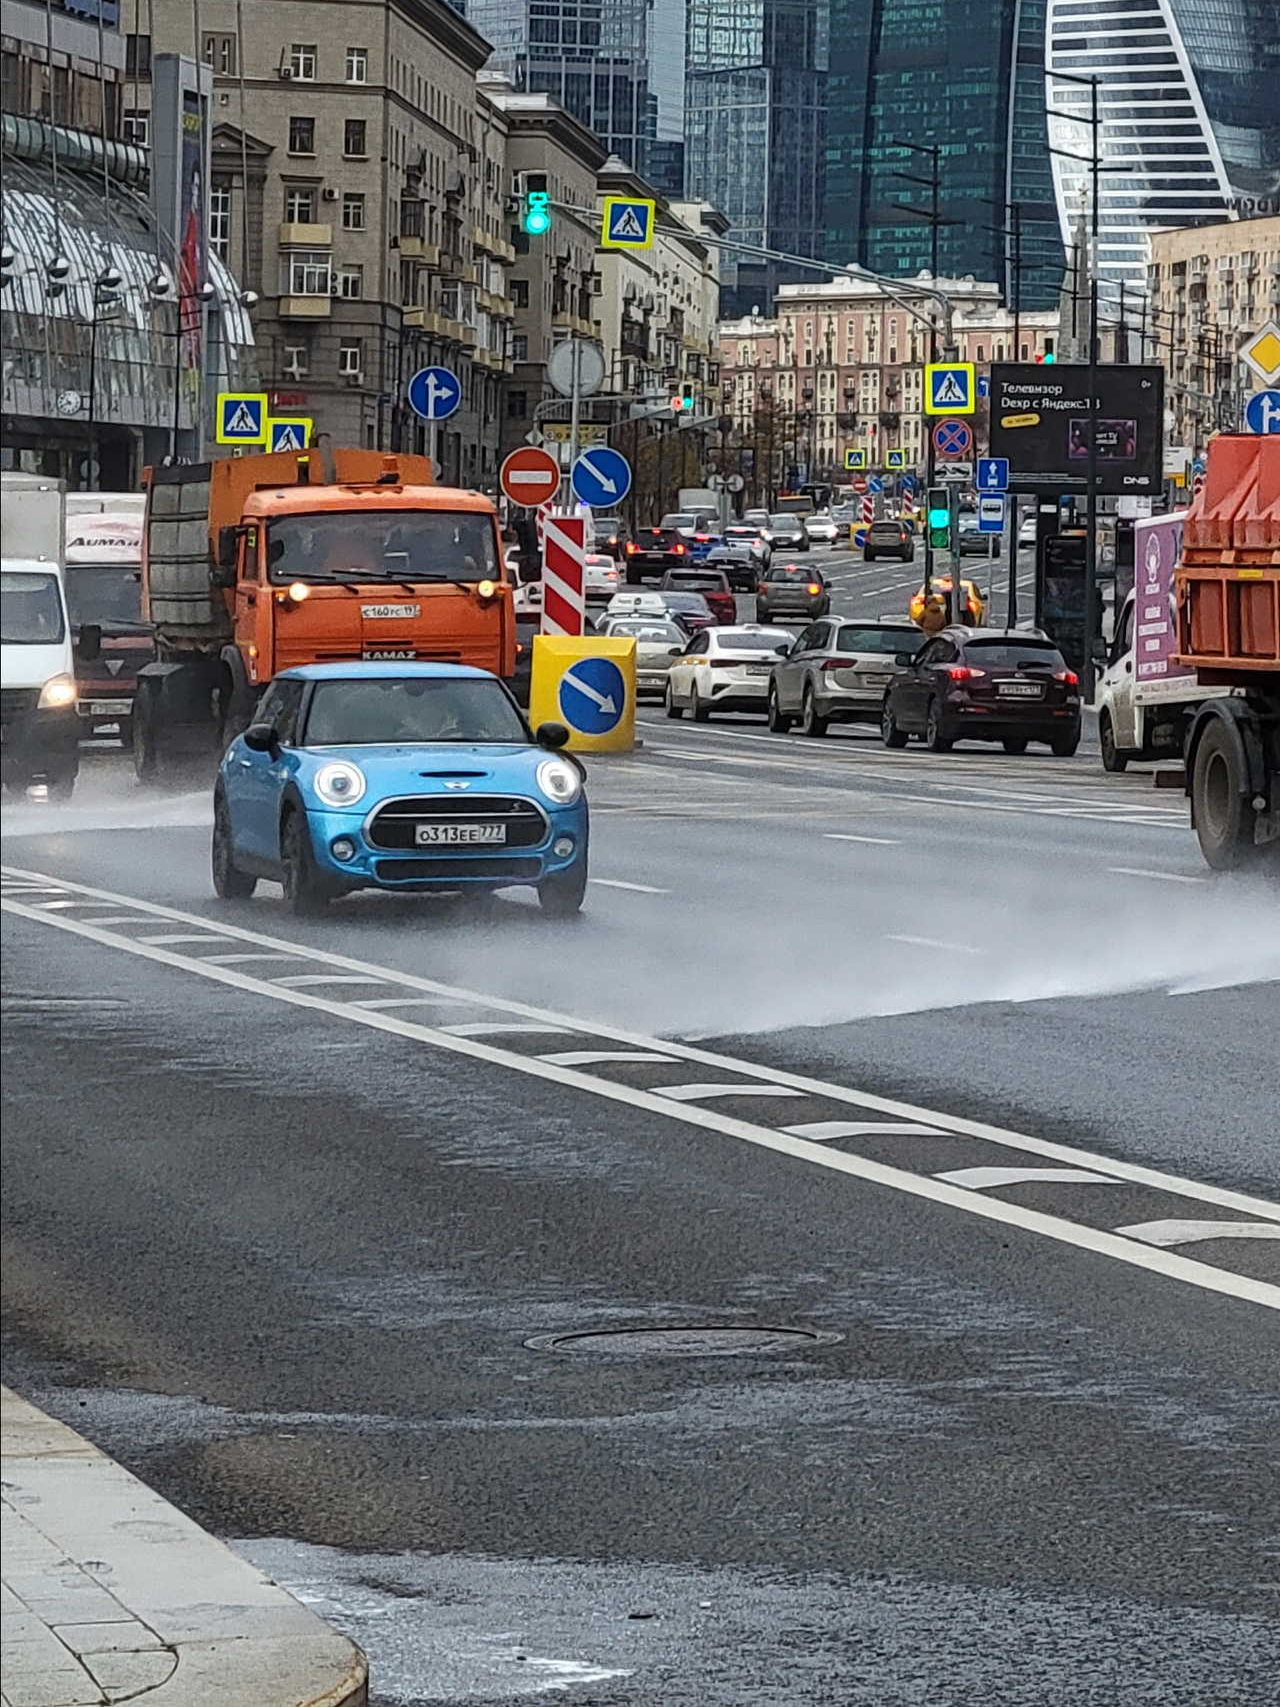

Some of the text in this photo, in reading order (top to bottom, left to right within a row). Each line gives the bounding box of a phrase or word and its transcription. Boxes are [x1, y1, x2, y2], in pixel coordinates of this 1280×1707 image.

[1001, 382, 1063, 395] Телевизор
[1001, 397, 1030, 410] Dexp
[1032, 400, 1040, 408] с
[1123, 476, 1150, 484] DNS
[362, 651, 416, 661] KAMAZ
[480, 825, 502, 837] 777
